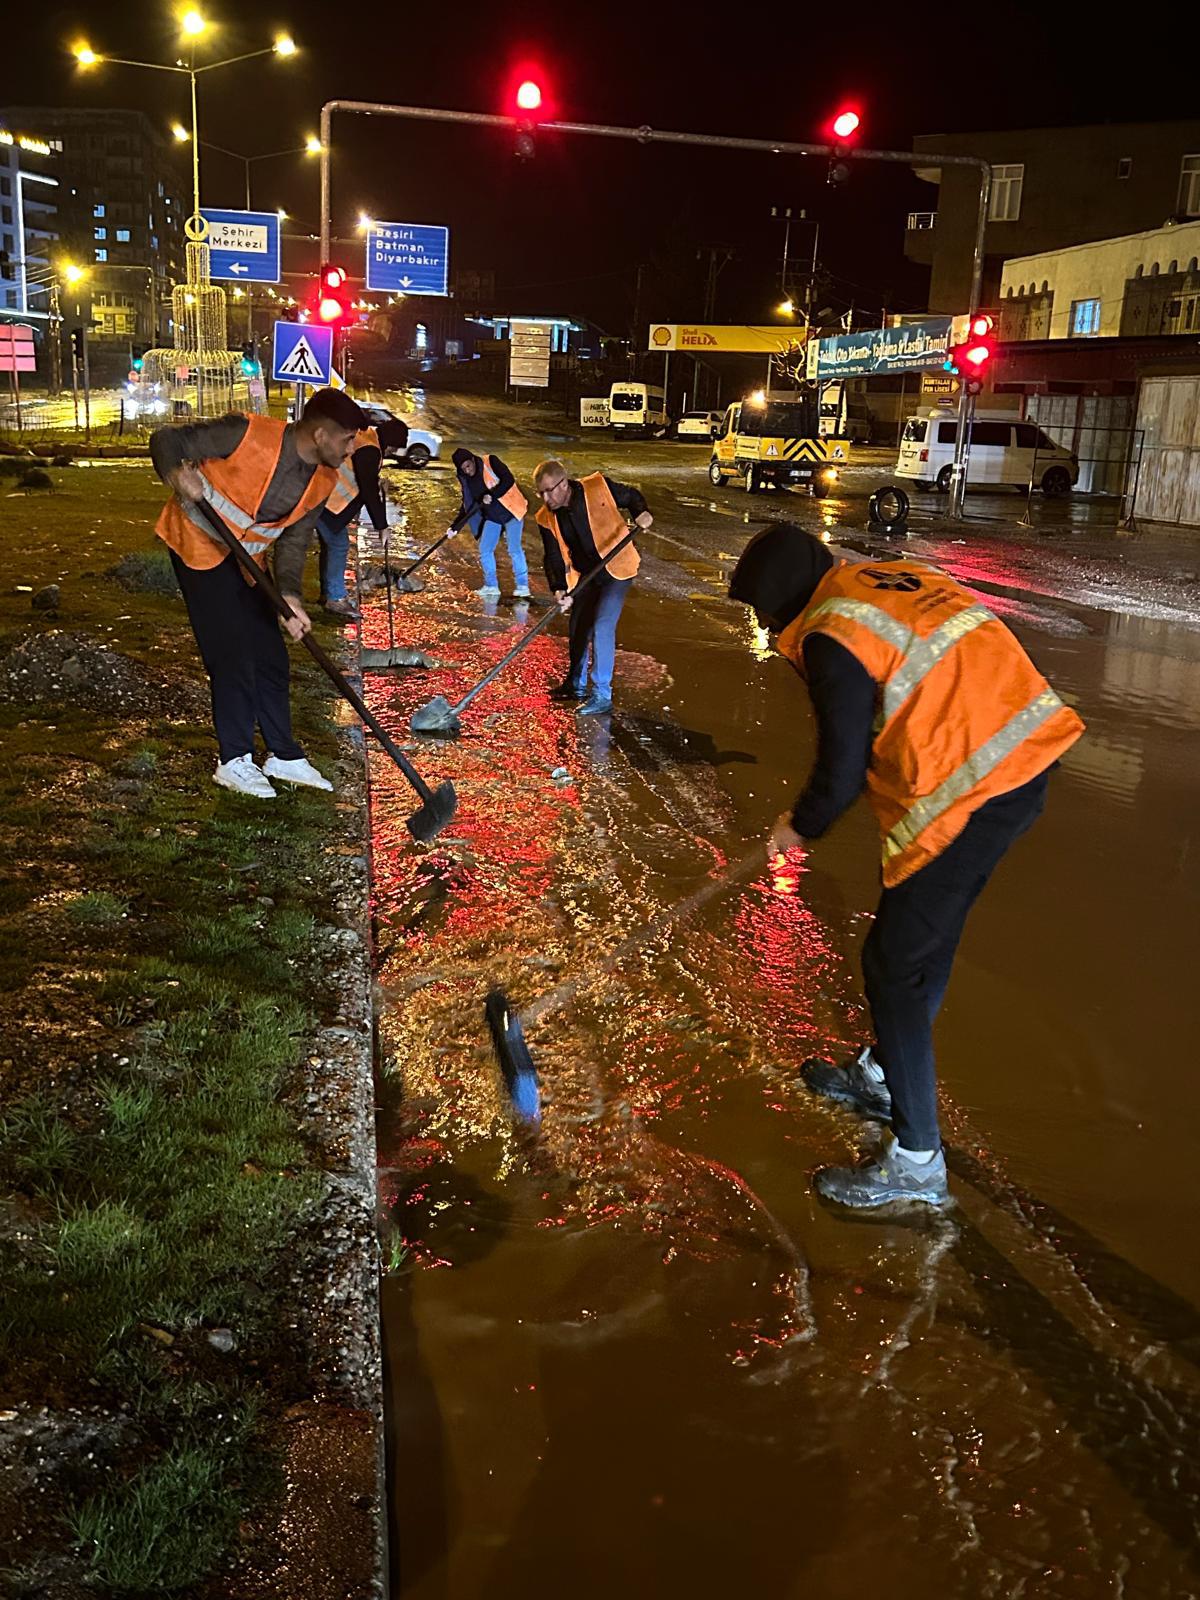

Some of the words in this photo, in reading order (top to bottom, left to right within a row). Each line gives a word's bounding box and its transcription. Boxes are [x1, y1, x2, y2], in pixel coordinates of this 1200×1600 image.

[212, 237, 262, 249] Merkezi
[376, 239, 424, 252] Batman
[376, 252, 440, 266] Diyarbakır
[682, 334, 718, 345] HELIX
